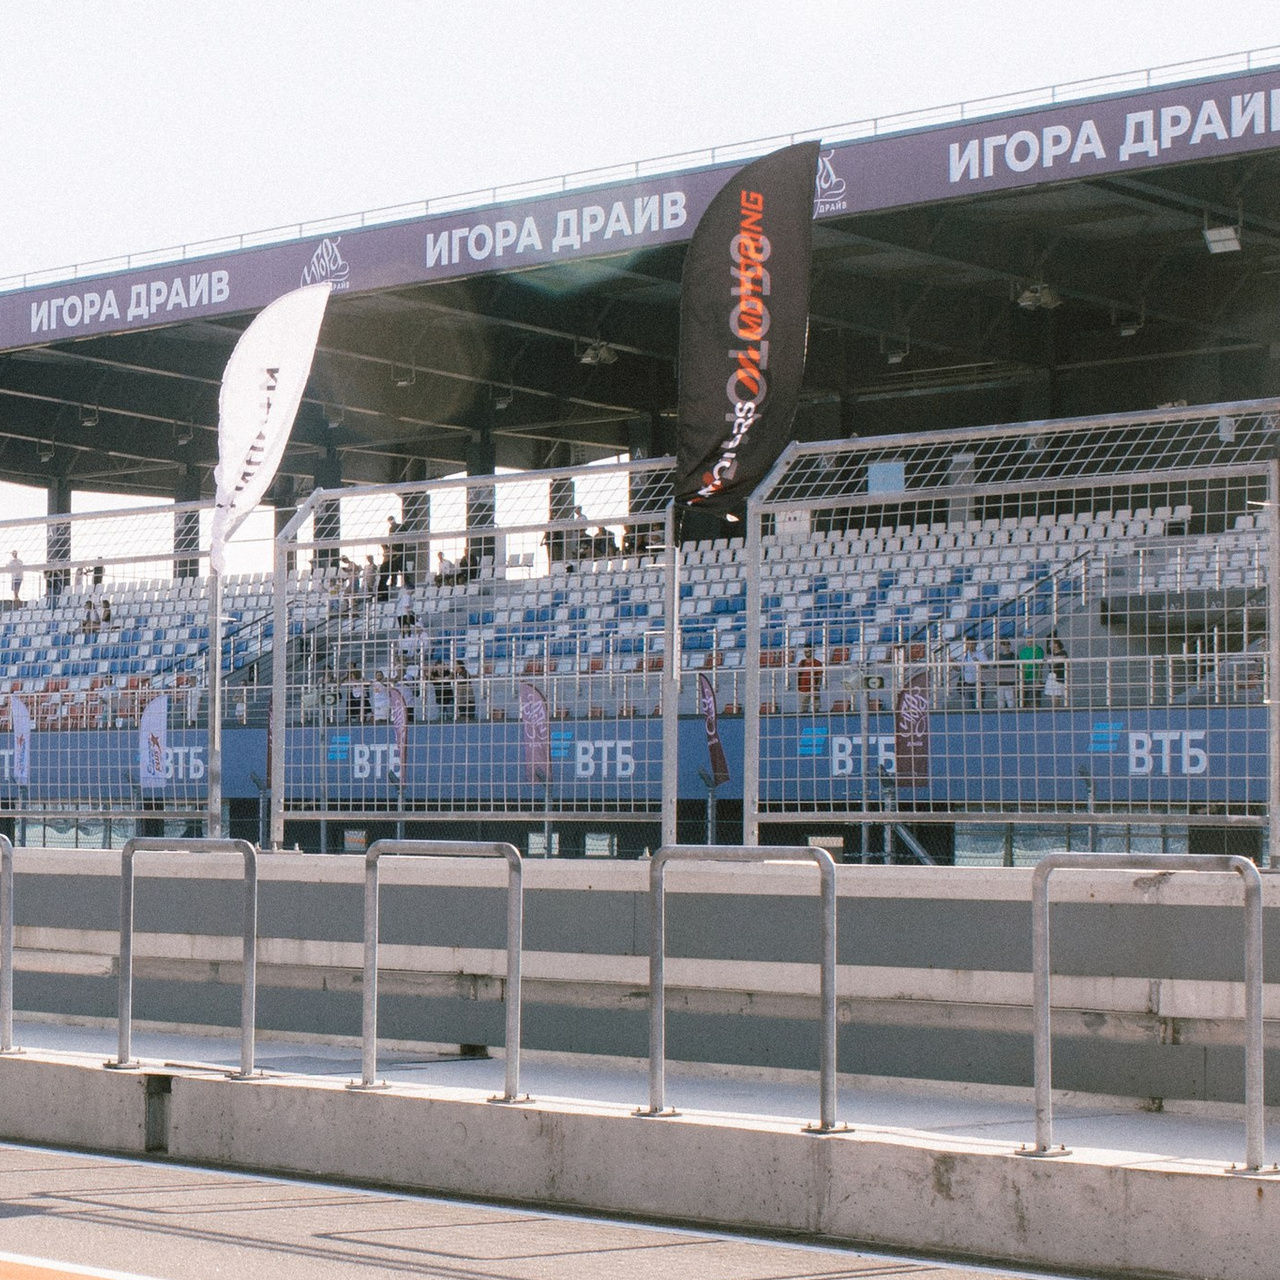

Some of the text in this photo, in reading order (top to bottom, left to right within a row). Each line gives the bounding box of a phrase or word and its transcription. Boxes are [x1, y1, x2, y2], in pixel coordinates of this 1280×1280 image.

[949, 88, 1280, 183] ИГОРА ДРАЙ
[425, 191, 688, 268] ИГОРА ДРАЙВ
[30, 288, 120, 333] ИГОРА
[127, 269, 231, 321] ДРАЙВ
[164, 746, 205, 780] ВТБ
[576, 740, 635, 778] ВТБ
[832, 736, 896, 777] ВТБ
[1128, 731, 1208, 776] ВТБ
